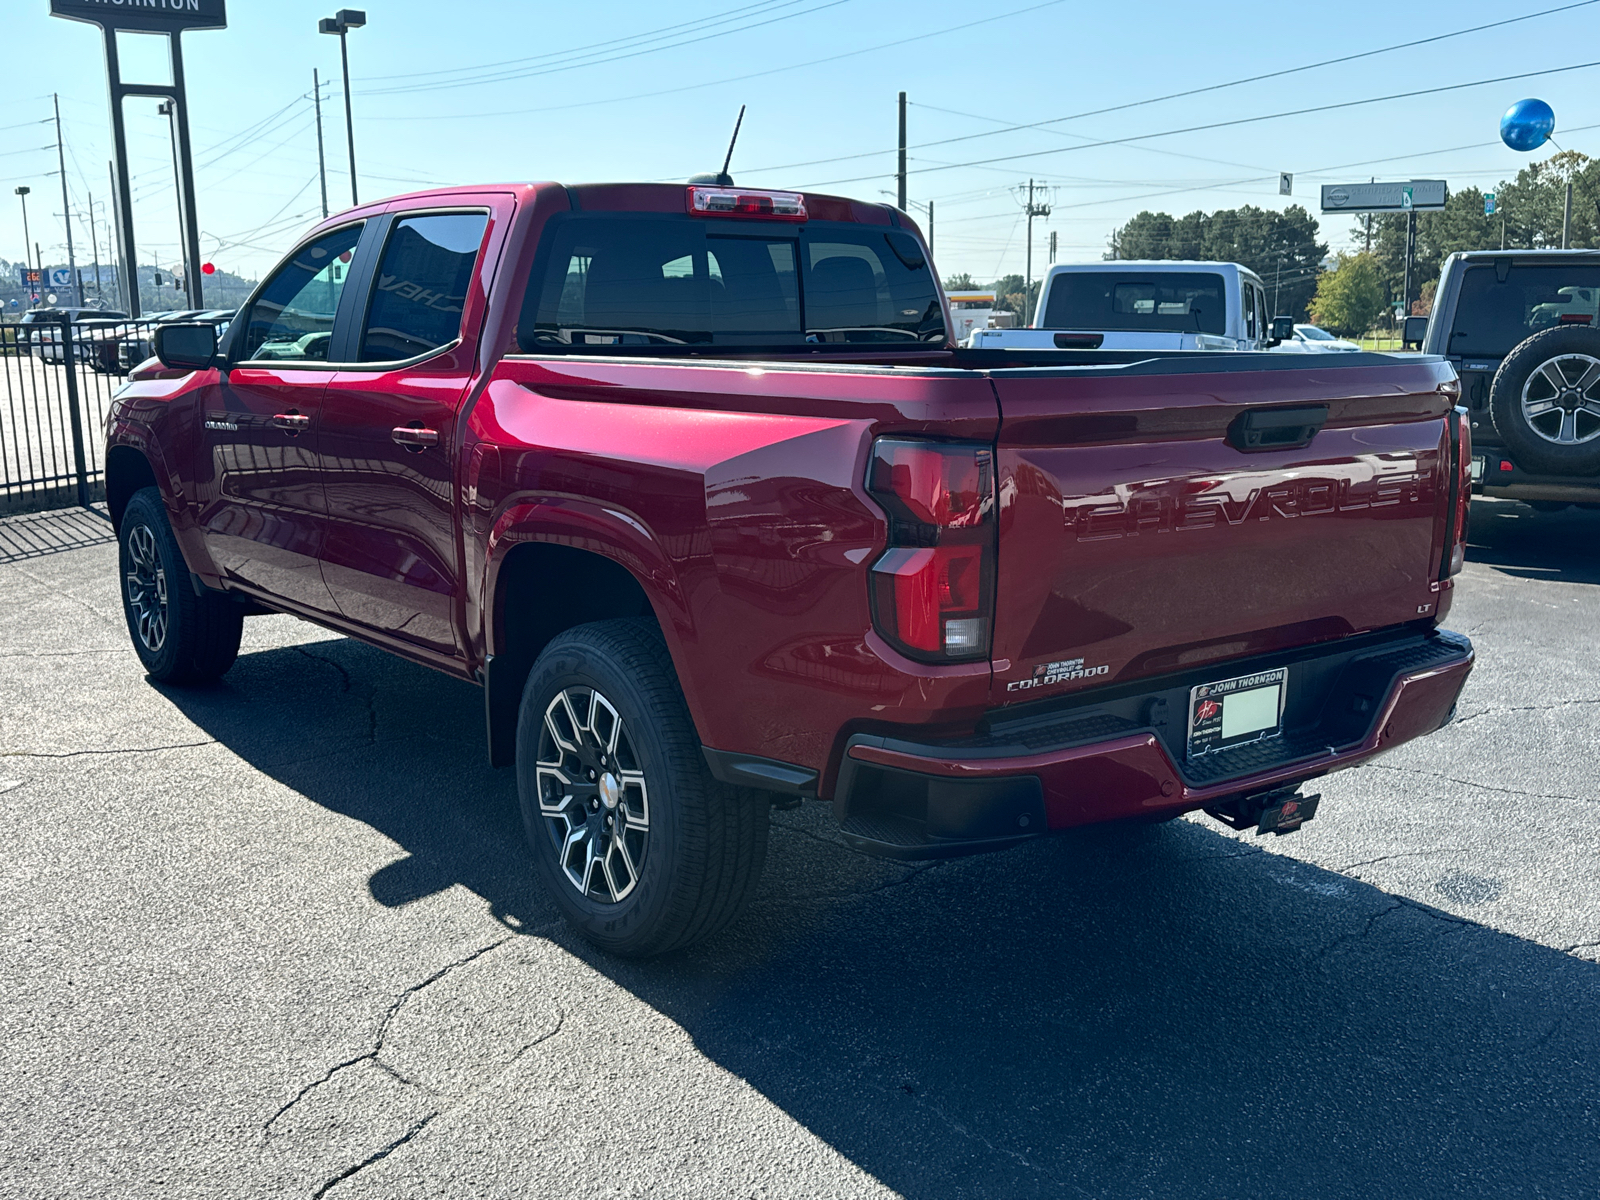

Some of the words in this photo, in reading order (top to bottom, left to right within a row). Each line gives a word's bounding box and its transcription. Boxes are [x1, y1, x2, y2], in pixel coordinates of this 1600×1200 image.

[1405, 196, 1409, 204] 6
[1076, 469, 1432, 542] CHEVROLET
[1417, 603, 1432, 614] LT
[1047, 665, 1074, 675] CHEVROLET
[1007, 665, 1109, 692] COLORADO
[1211, 681, 1237, 694] JOHN
